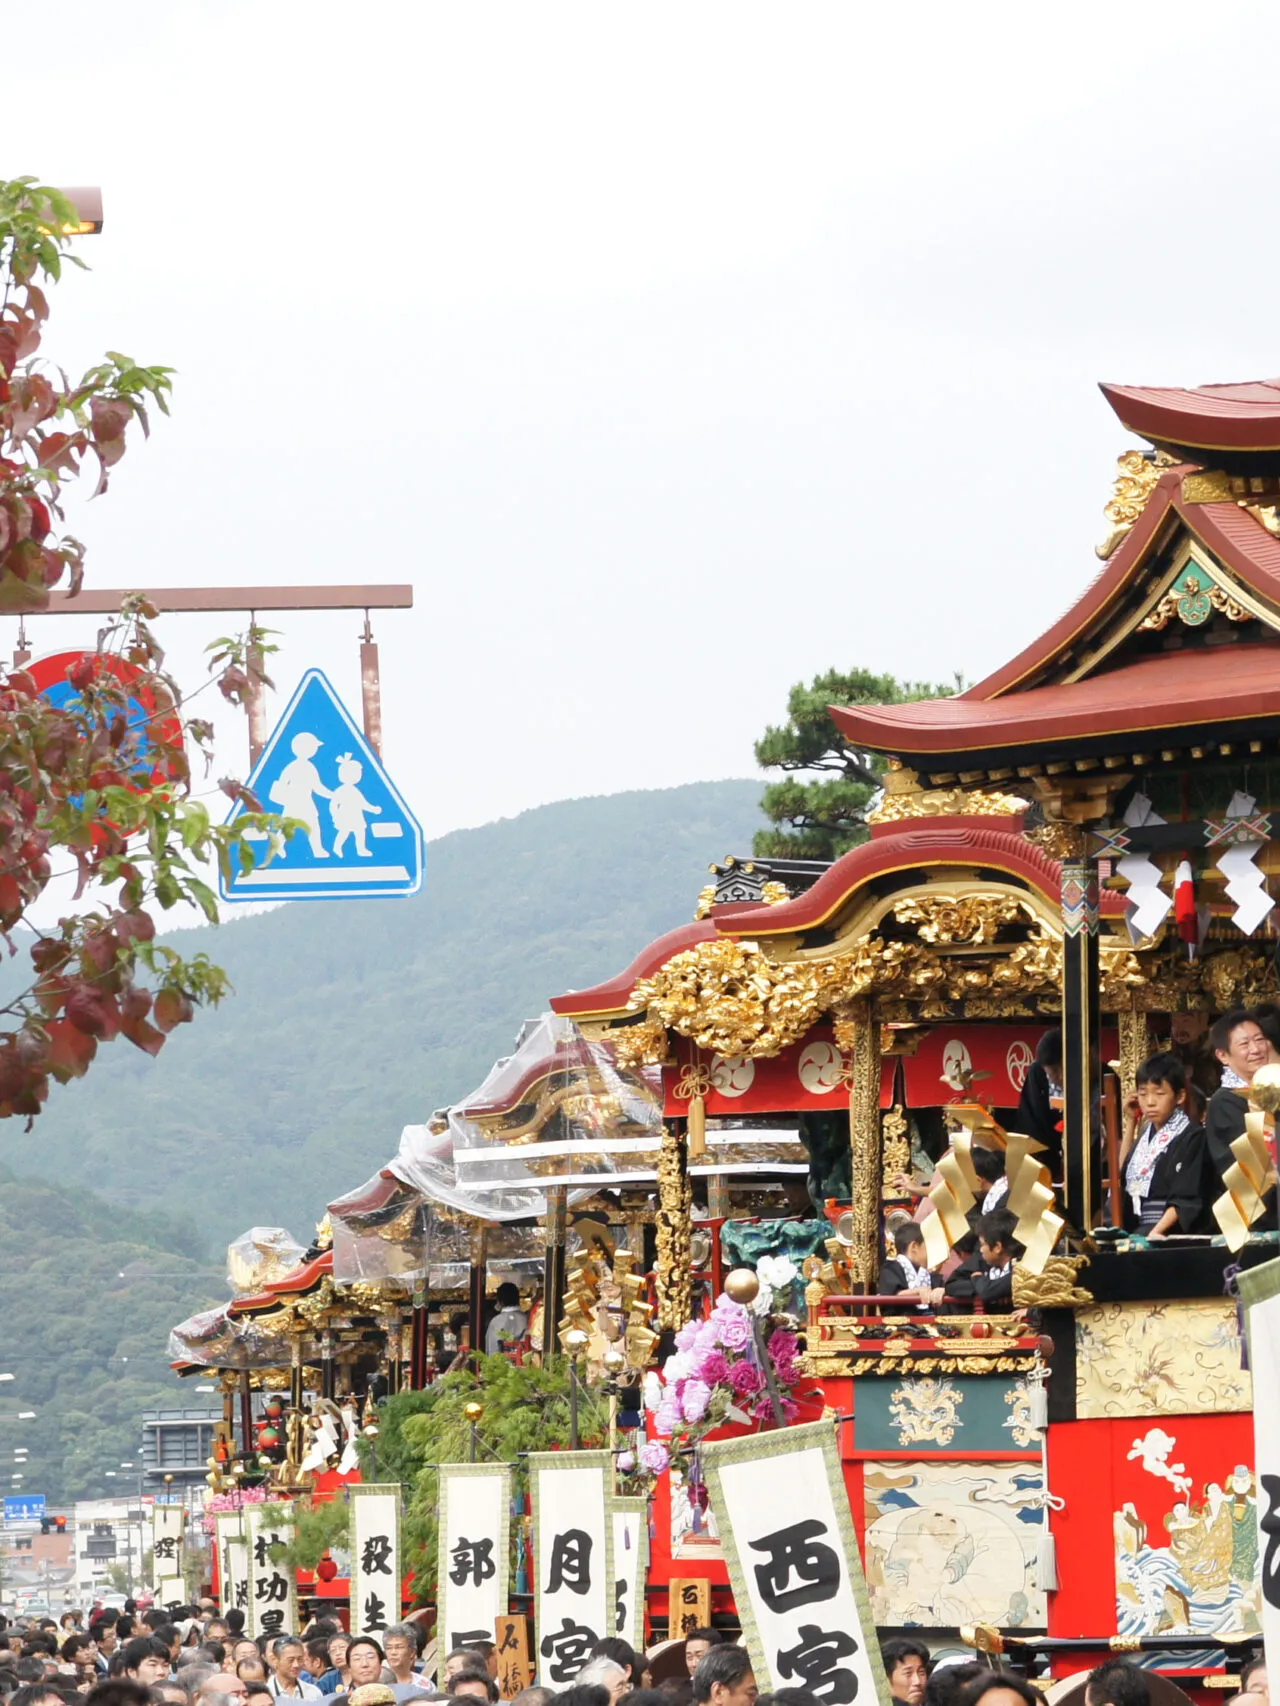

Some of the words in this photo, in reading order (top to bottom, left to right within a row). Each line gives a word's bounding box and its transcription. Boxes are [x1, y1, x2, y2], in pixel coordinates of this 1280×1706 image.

[361, 1535, 394, 1634] 殺生
[541, 1529, 601, 1683] 月宮
[748, 1519, 860, 1705] 西宮
